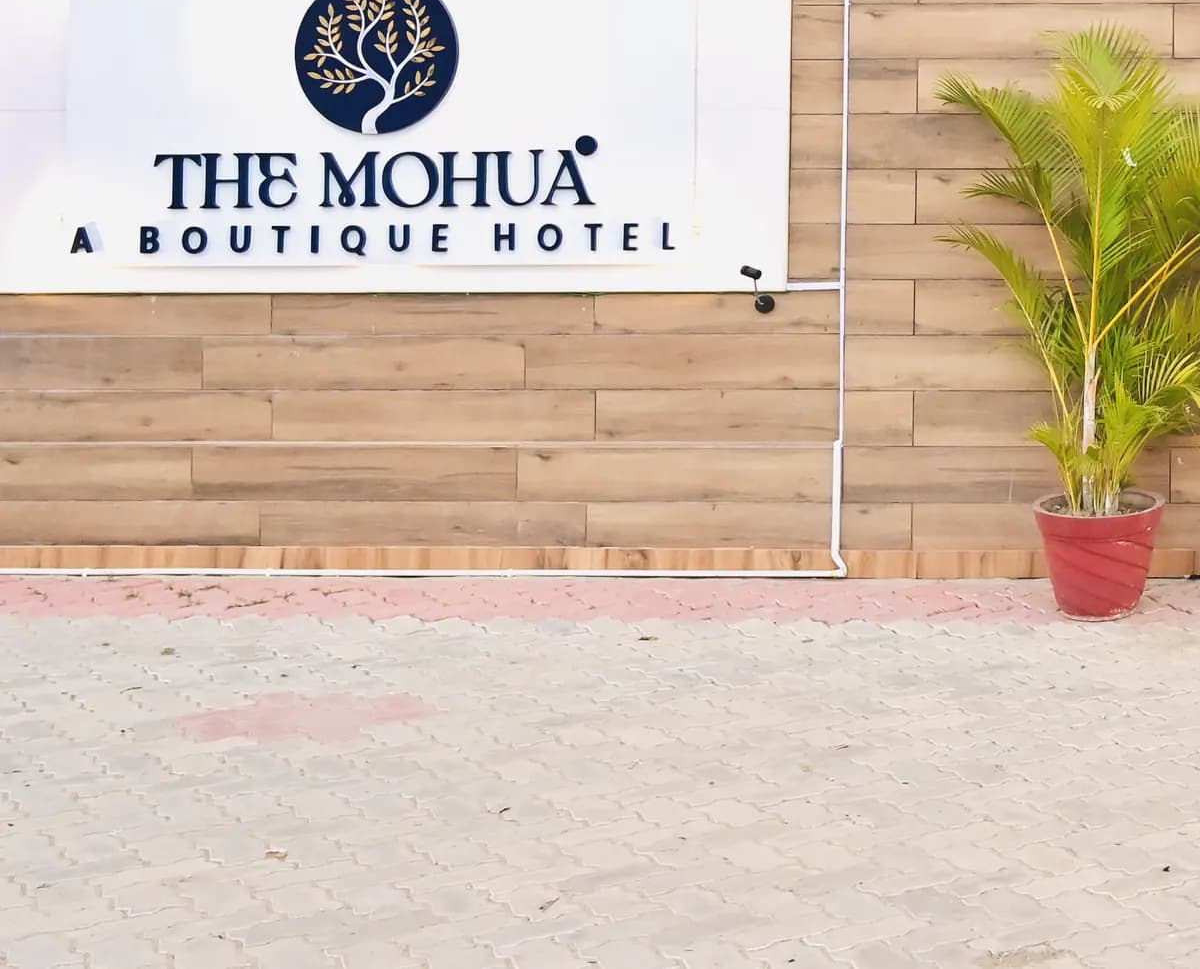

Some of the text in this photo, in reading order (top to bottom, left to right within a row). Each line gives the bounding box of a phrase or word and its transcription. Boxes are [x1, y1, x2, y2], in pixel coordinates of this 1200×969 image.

[153, 148, 597, 210] THE MOHUA
[70, 222, 677, 257] A BOUTIQUE HOTEL
